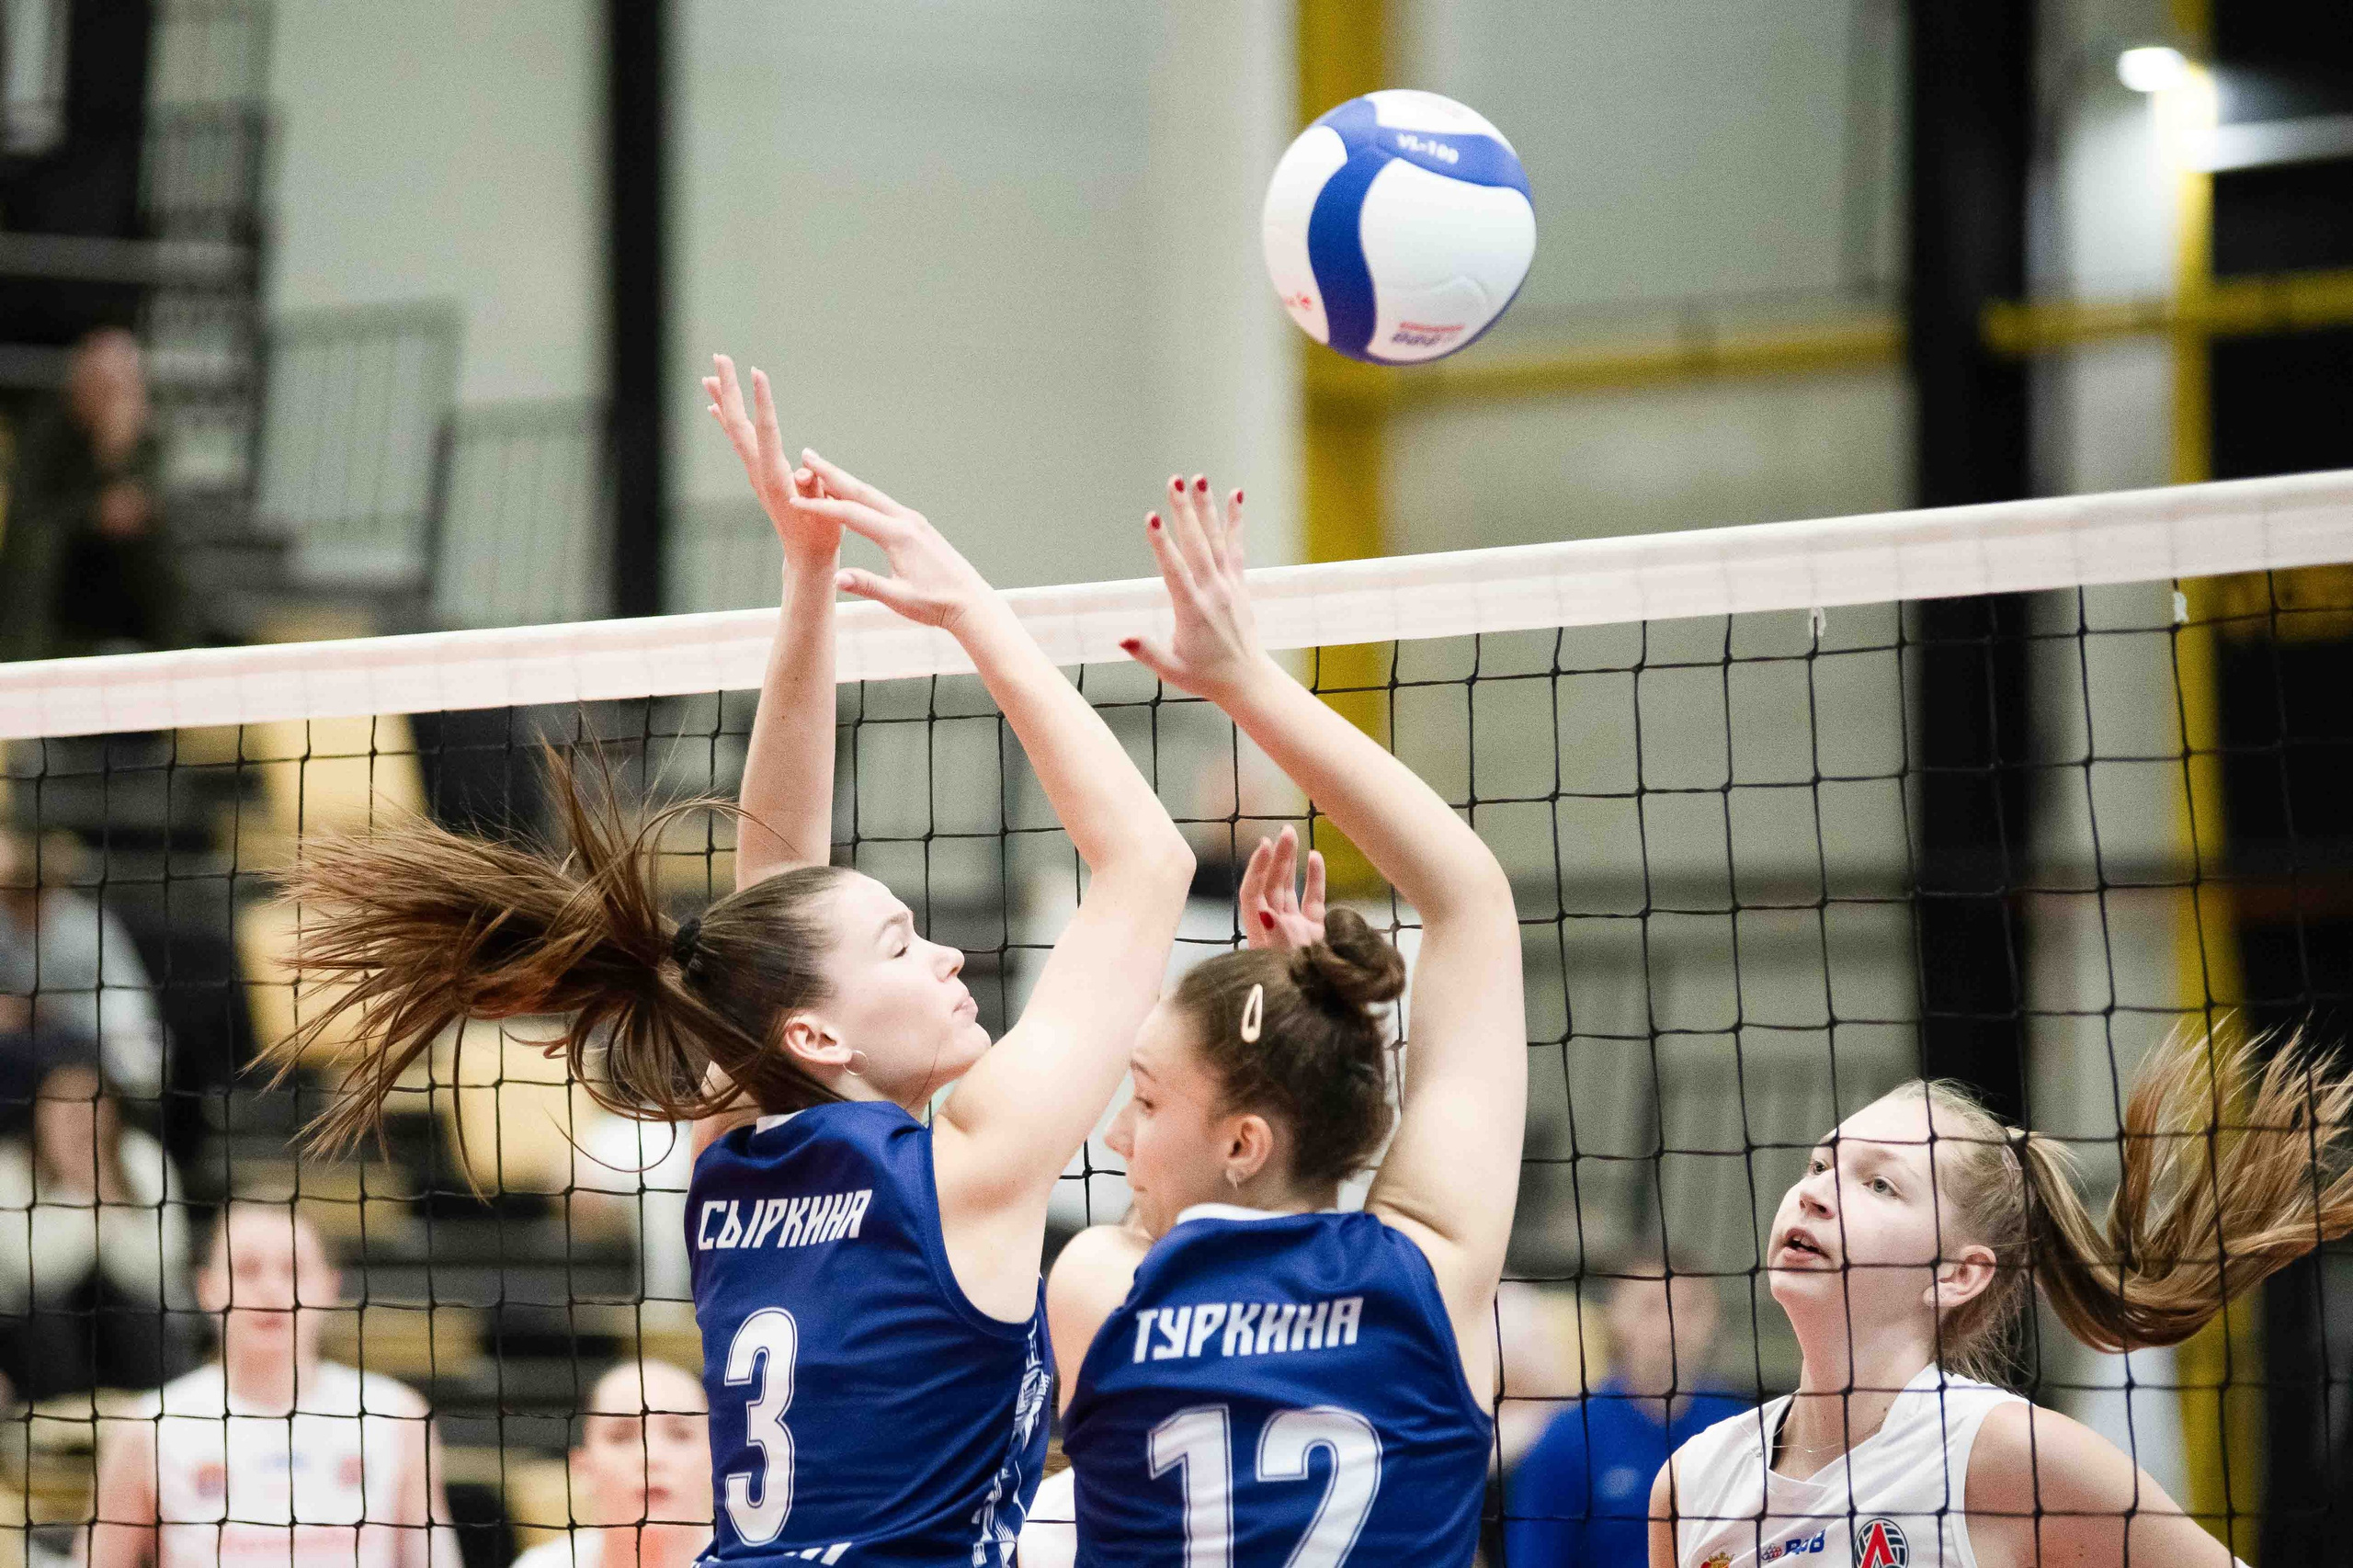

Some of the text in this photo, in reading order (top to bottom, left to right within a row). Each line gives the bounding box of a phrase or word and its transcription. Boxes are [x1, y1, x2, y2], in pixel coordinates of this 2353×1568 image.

[698, 1189, 872, 1250] СЫРКИНА
[1133, 1297, 1365, 1364] ТУРКИНА
[724, 1306, 798, 1548] 3
[1146, 1403, 1383, 1568] 12
